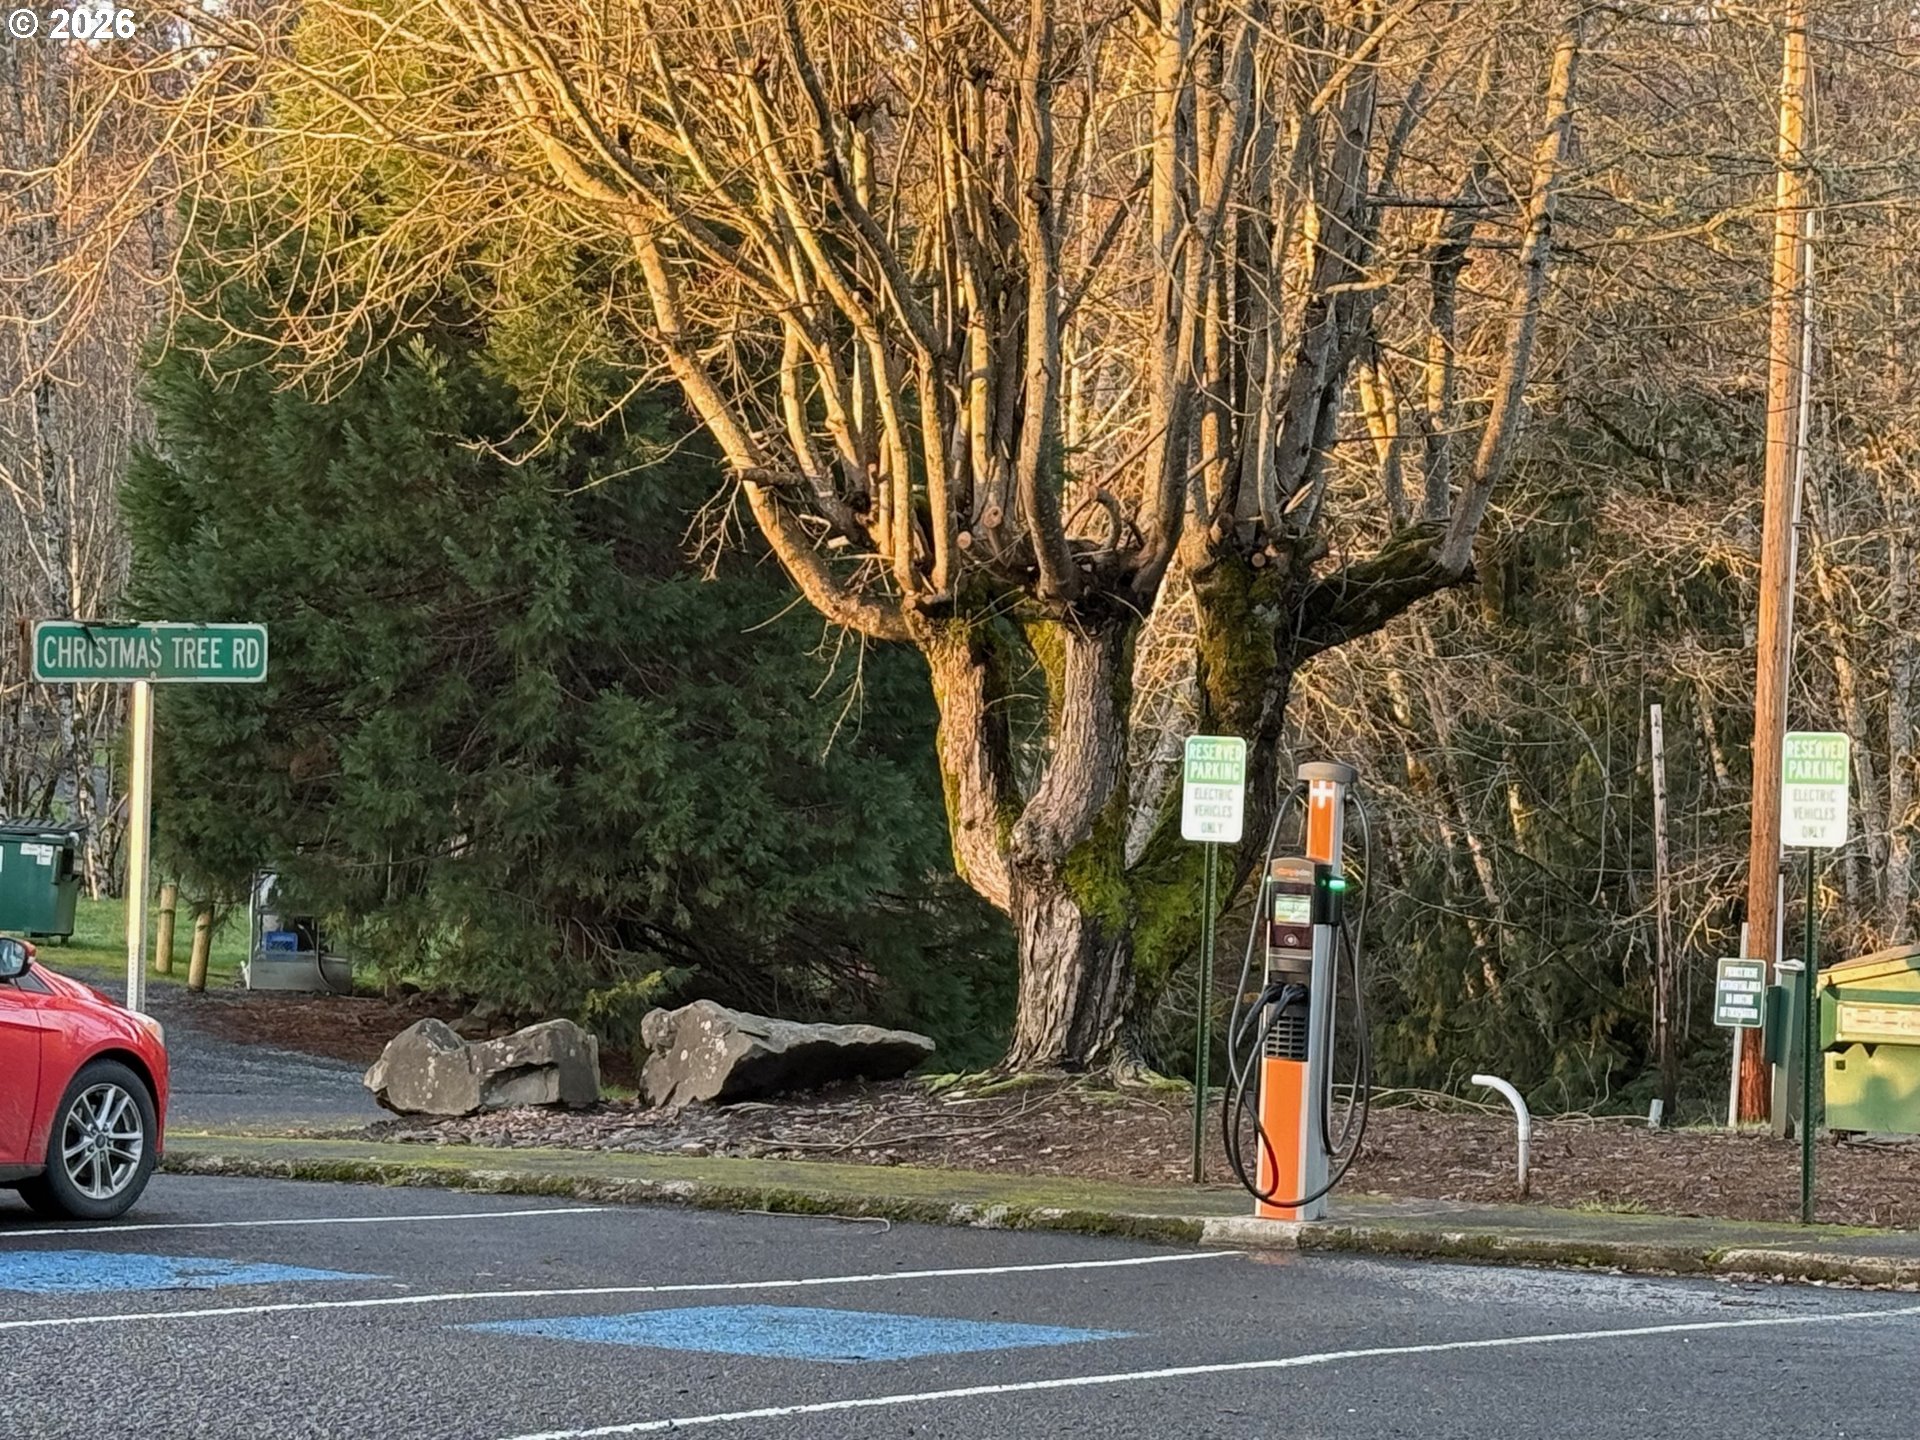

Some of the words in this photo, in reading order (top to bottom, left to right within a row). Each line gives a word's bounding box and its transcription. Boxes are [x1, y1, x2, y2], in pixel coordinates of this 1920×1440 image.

[43, 636, 162, 669] CHRISTMAS
[172, 637, 223, 669] TREE
[232, 637, 260, 669] RD
[1189, 743, 1242, 761] RESERVED
[1786, 740, 1845, 759] RESERVED
[1190, 761, 1240, 781] PARKING
[1788, 760, 1843, 780] PARKING
[1194, 788, 1233, 801] ELECTRIC
[1793, 788, 1836, 802] ELECTRIC
[1194, 805, 1233, 818] VEHICLES
[1793, 807, 1836, 821] VEHICLES
[1201, 822, 1223, 833] ONLY
[1801, 825, 1826, 838] ONLY
